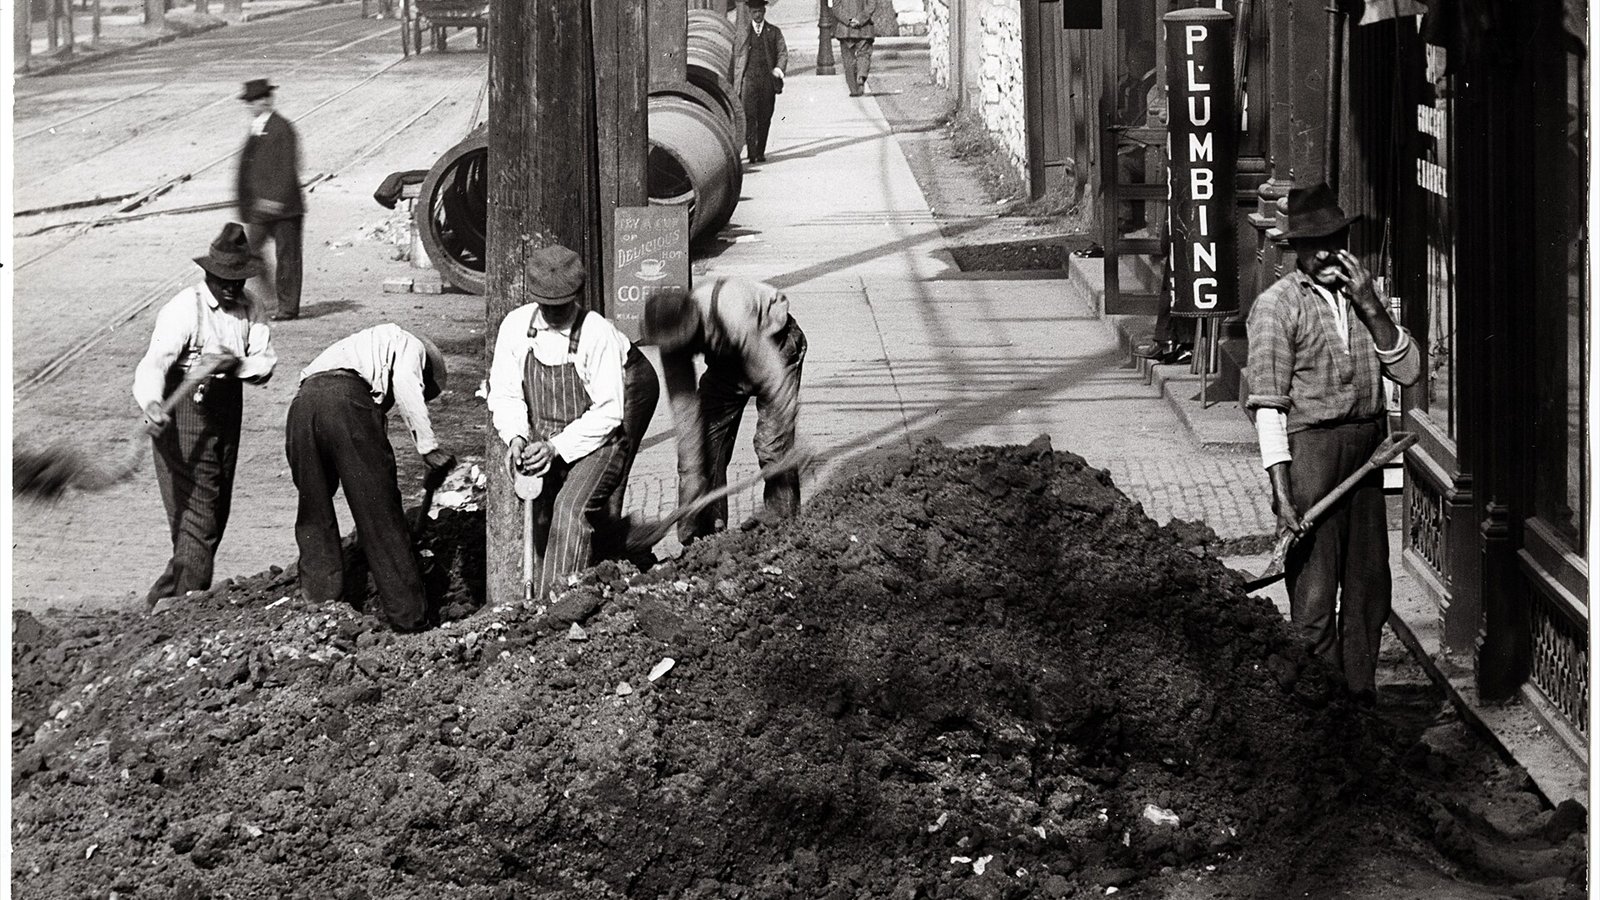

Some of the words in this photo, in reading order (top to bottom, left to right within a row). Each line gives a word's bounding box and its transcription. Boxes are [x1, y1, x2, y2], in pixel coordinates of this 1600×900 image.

[1186, 25, 1218, 309] PLUMBING
[618, 229, 680, 268] DELICIOUS
[661, 250, 682, 259] HOT
